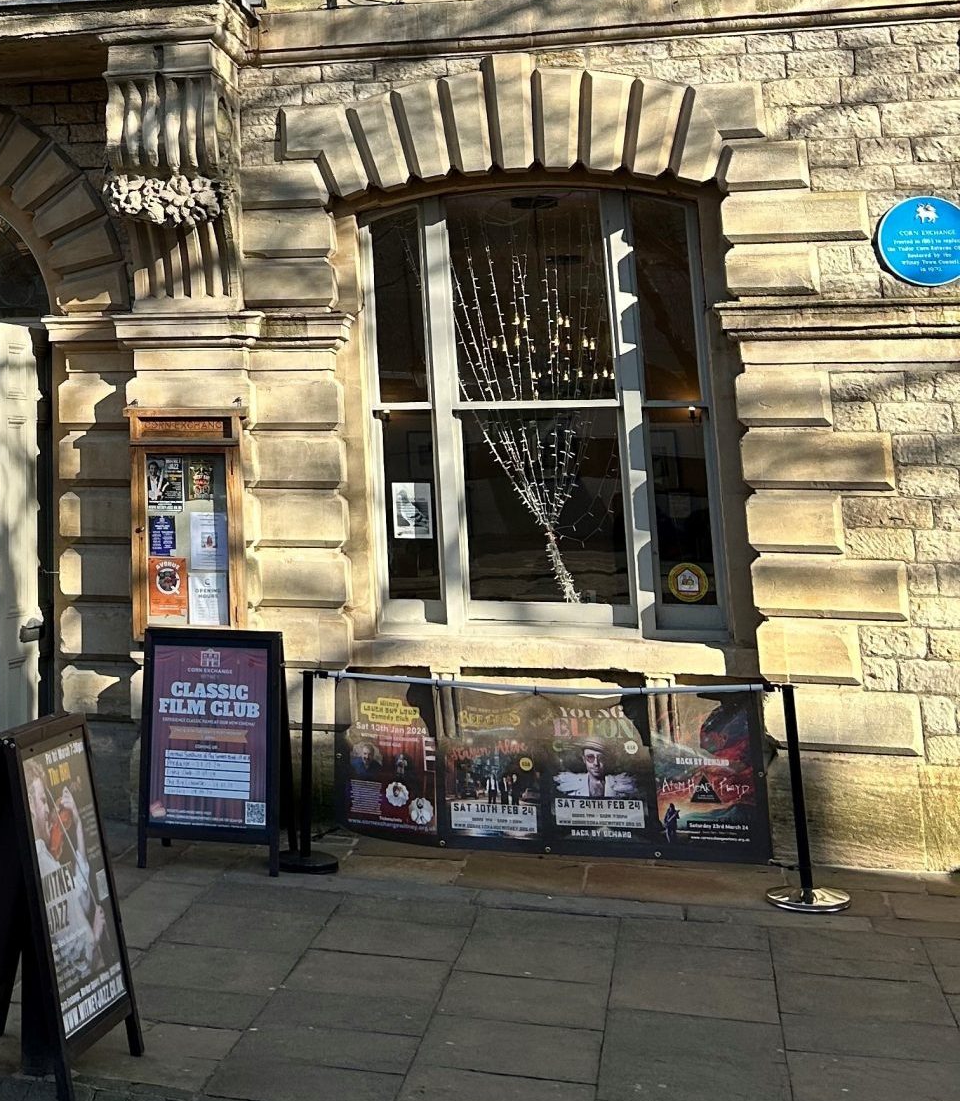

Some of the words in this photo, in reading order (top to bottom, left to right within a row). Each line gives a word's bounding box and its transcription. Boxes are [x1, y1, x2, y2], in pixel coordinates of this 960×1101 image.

[144, 421, 171, 430] CORN
[155, 560, 181, 571] AVENUE
[171, 681, 249, 701] CLASSIC
[158, 697, 206, 716] FILM
[210, 700, 260, 718] CLUB
[379, 700, 400, 708] Witney
[371, 713, 394, 721] Comedy
[400, 708, 418, 716] LOUD
[559, 704, 625, 718] YOUNG
[355, 721, 369, 730] Sat
[371, 724, 389, 732] 13th
[389, 726, 405, 734] Jan
[406, 726, 427, 735] 2024
[553, 717, 635, 739] ELTON
[675, 757, 692, 766] BACK
[693, 758, 703, 766] BY
[703, 758, 730, 767] DEMAND
[453, 803, 471, 812] SAT
[476, 803, 498, 814] 10TH
[501, 805, 519, 814] FEB
[522, 806, 534, 816] 24
[557, 799, 575, 809] SAT
[579, 800, 604, 809] 24TH
[607, 801, 625, 810] FEB
[628, 801, 641, 811] 24
[688, 822, 712, 830] Saturday
[571, 829, 590, 837] BACK
[603, 830, 632, 839] DEMAND
[41, 861, 76, 905] WITNEY
[48, 899, 70, 936] JAZZ
